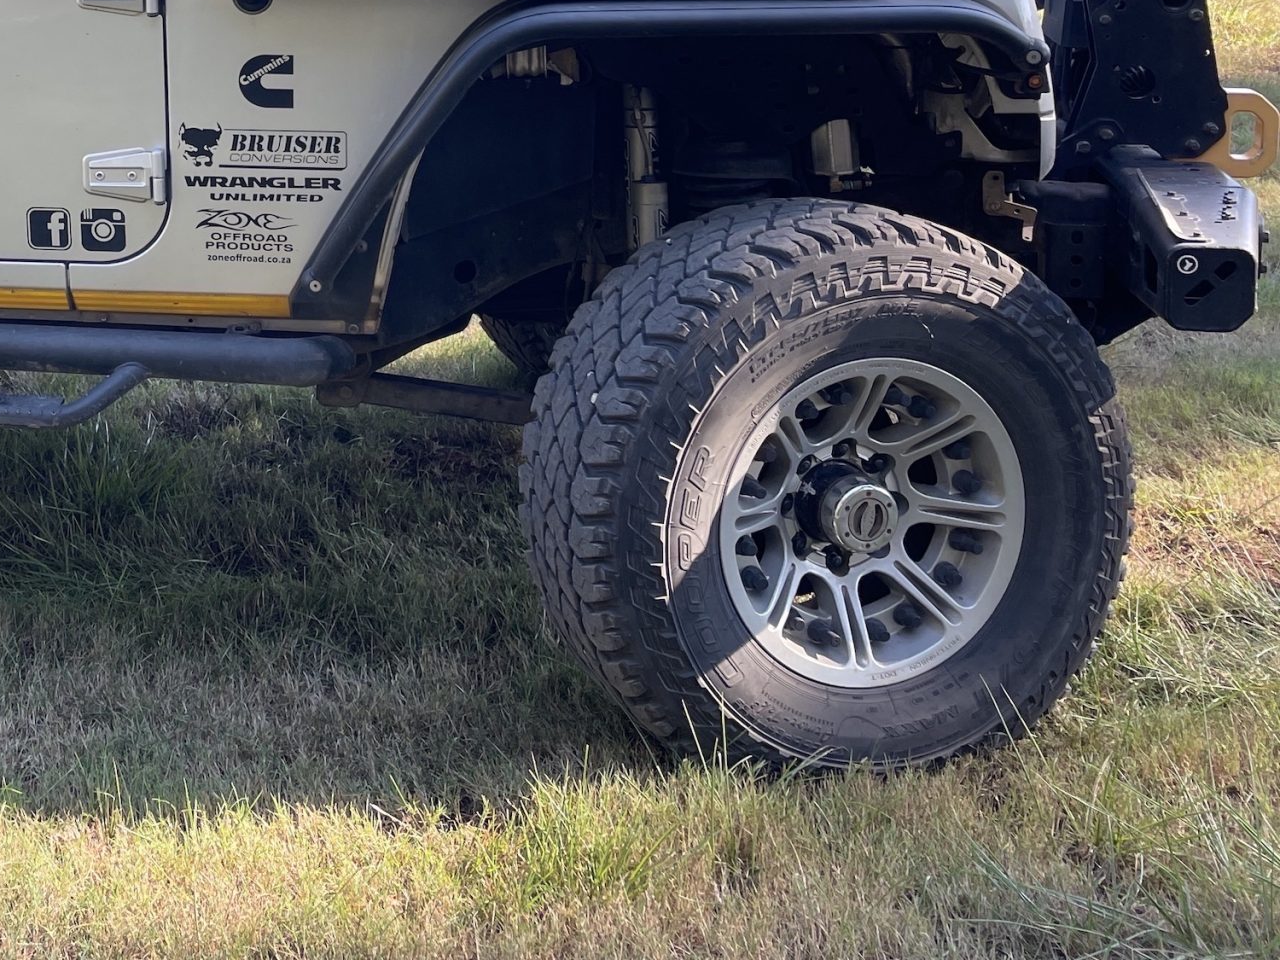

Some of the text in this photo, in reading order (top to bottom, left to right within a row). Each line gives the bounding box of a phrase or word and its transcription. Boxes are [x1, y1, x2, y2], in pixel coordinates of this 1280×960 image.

[239, 54, 290, 86] Cummins
[230, 134, 341, 154] BRUISER
[229, 153, 339, 165] CONVERSIONS
[184, 176, 342, 191] WRANGLER
[210, 193, 324, 203] UNLIMITED
[210, 232, 288, 243] OFFROAD
[205, 241, 294, 252] PRODUCTS
[207, 254, 291, 264] zoneoffroad.co.za
[677, 446, 745, 688] COOPER
